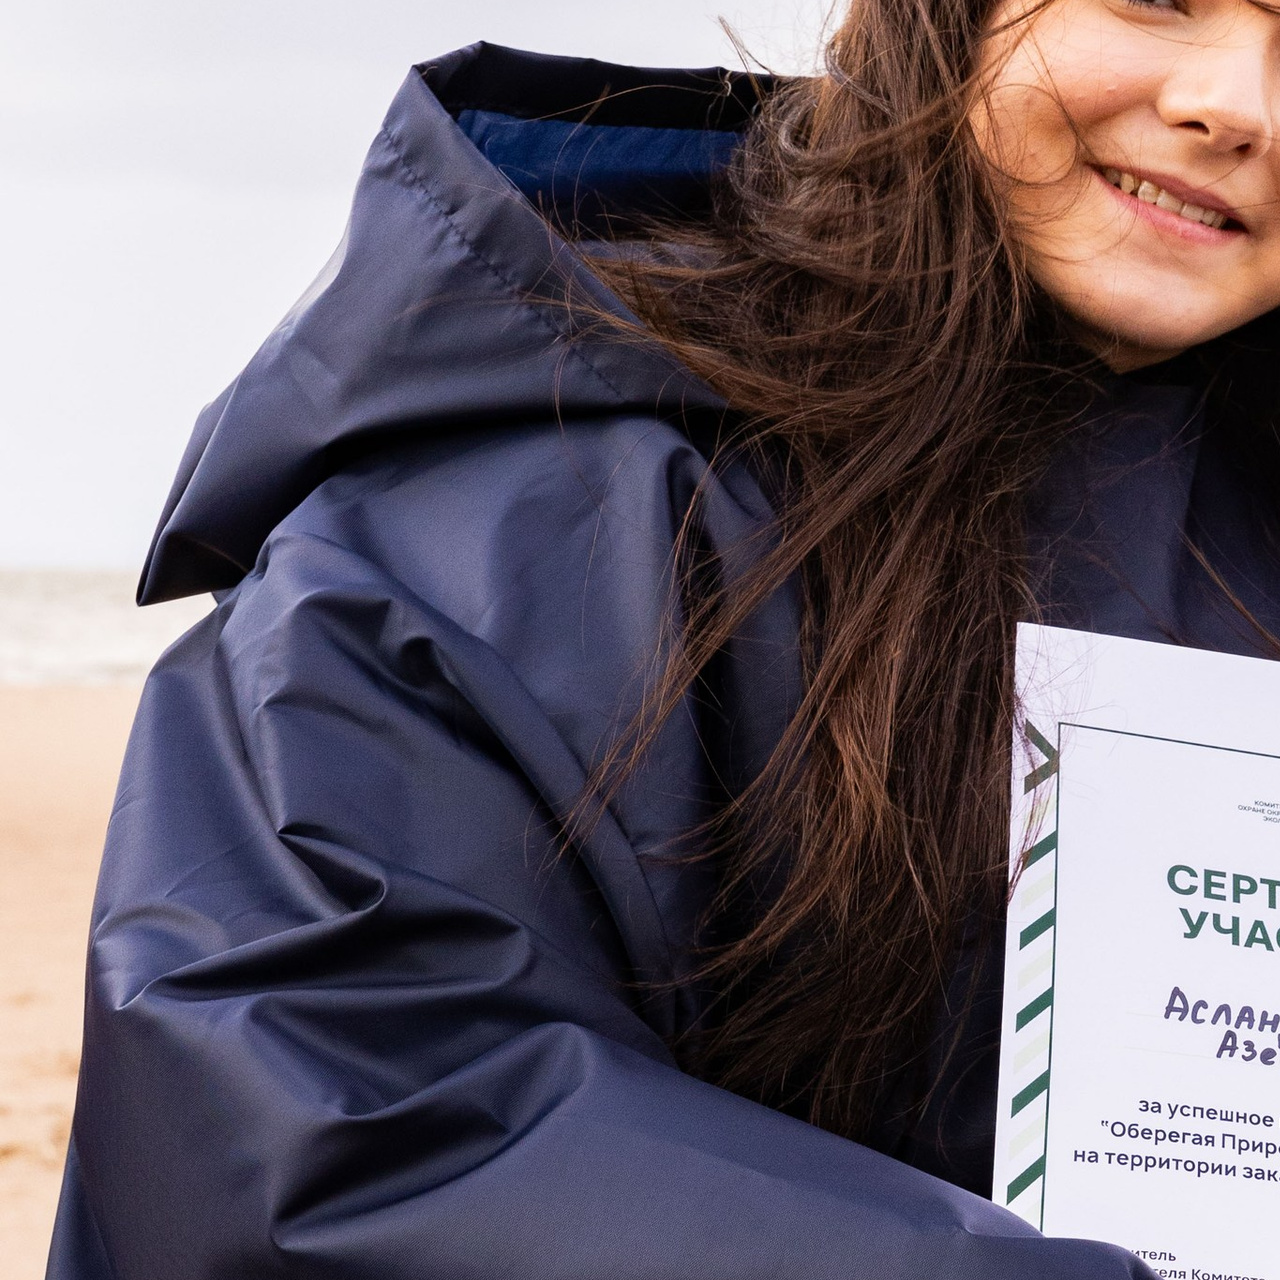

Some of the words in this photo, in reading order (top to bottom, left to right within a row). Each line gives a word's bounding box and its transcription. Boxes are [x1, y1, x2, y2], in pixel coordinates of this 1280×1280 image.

[1237, 804, 1266, 815] ОХРАНЕ
[1138, 1099, 1162, 1114] за
[1167, 1102, 1275, 1127] успешное
[1073, 1149, 1099, 1164] на
[1104, 1150, 1237, 1178] территории
[1153, 1268, 1187, 1280] еля
